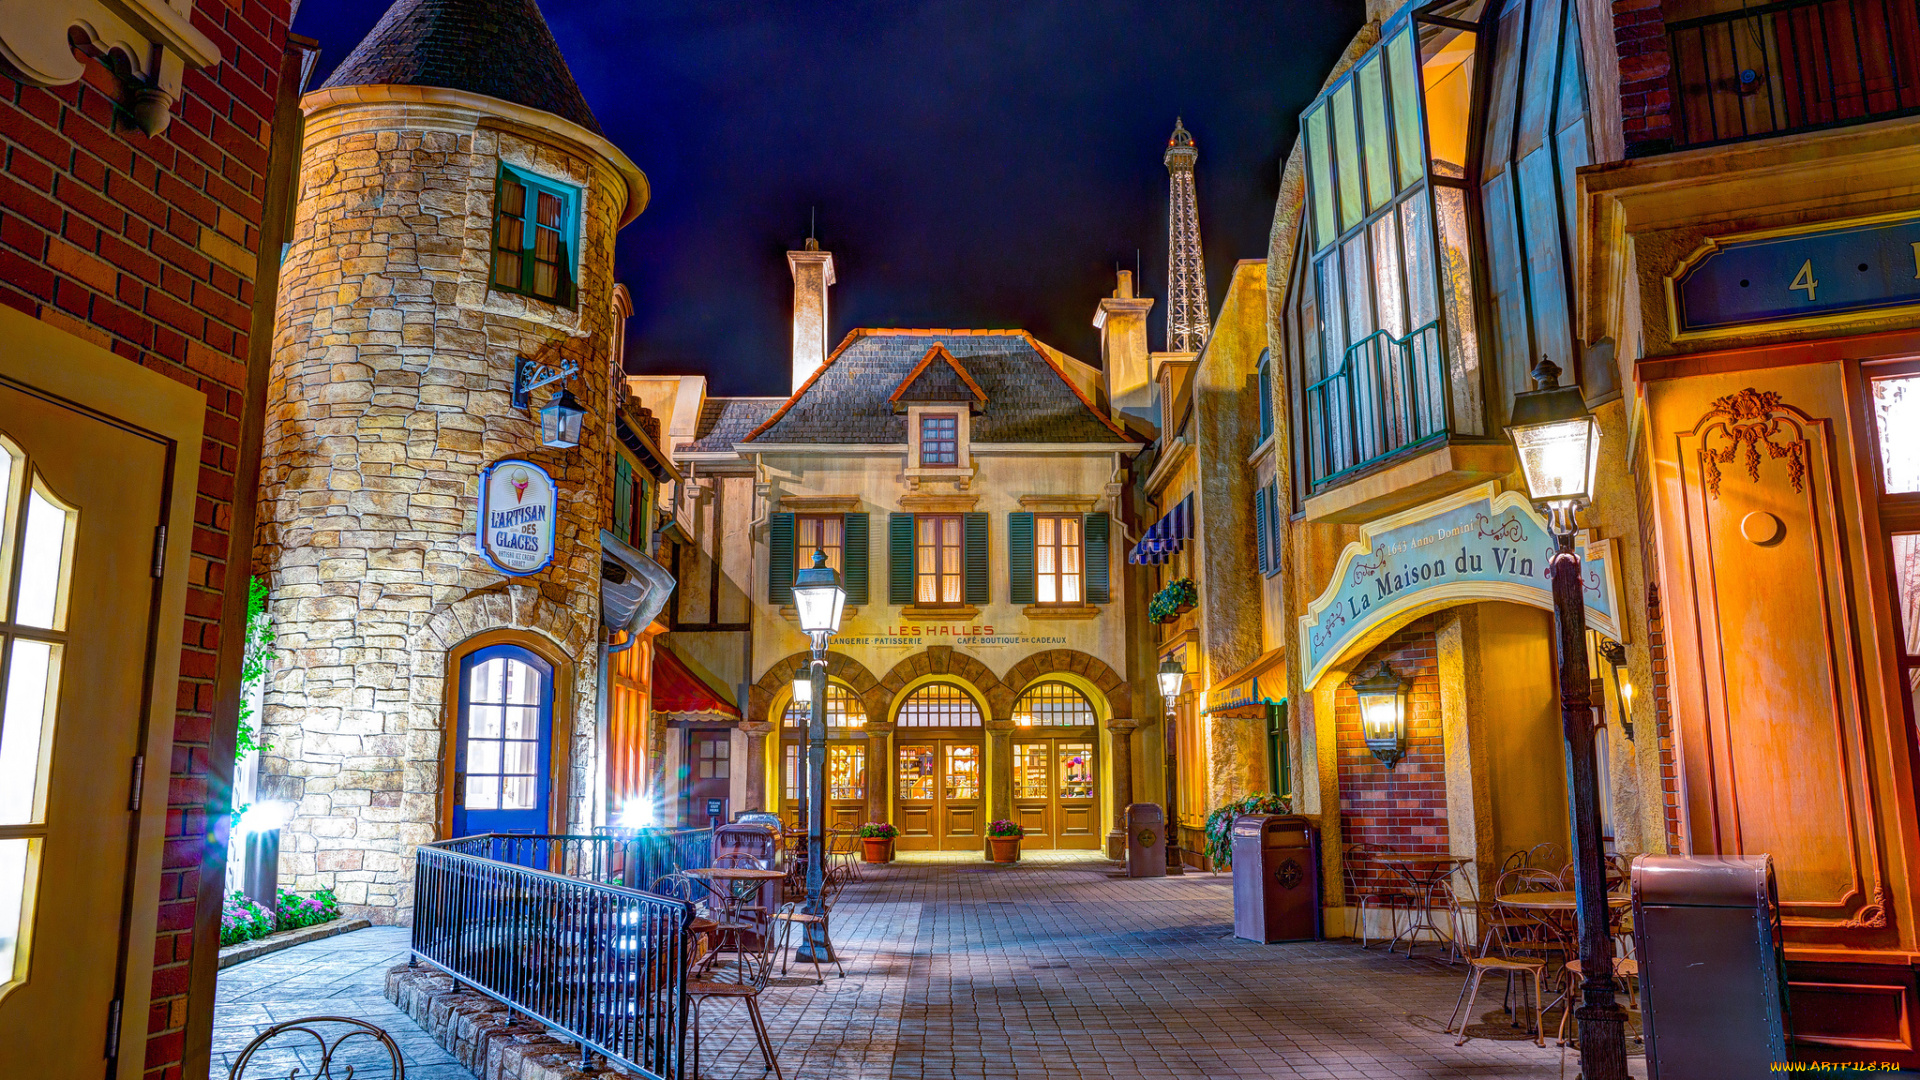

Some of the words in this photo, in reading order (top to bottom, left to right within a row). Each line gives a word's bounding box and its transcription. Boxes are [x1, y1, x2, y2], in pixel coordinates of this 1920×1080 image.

[1788, 258, 1819, 301] 4
[491, 505, 546, 528] L'ARTISAN
[521, 523, 537, 535] DES
[1411, 537, 1435, 549] Anno
[1438, 519, 1474, 541] Domini
[496, 531, 539, 552] GLACES
[1348, 594, 1371, 620] La
[1375, 559, 1446, 601] Maison
[1455, 546, 1483, 574] du
[1492, 547, 1534, 578] Vin
[888, 625, 921, 636] LES
[926, 625, 995, 636] HALLES
[1030, 637, 1067, 645] CADEAUX
